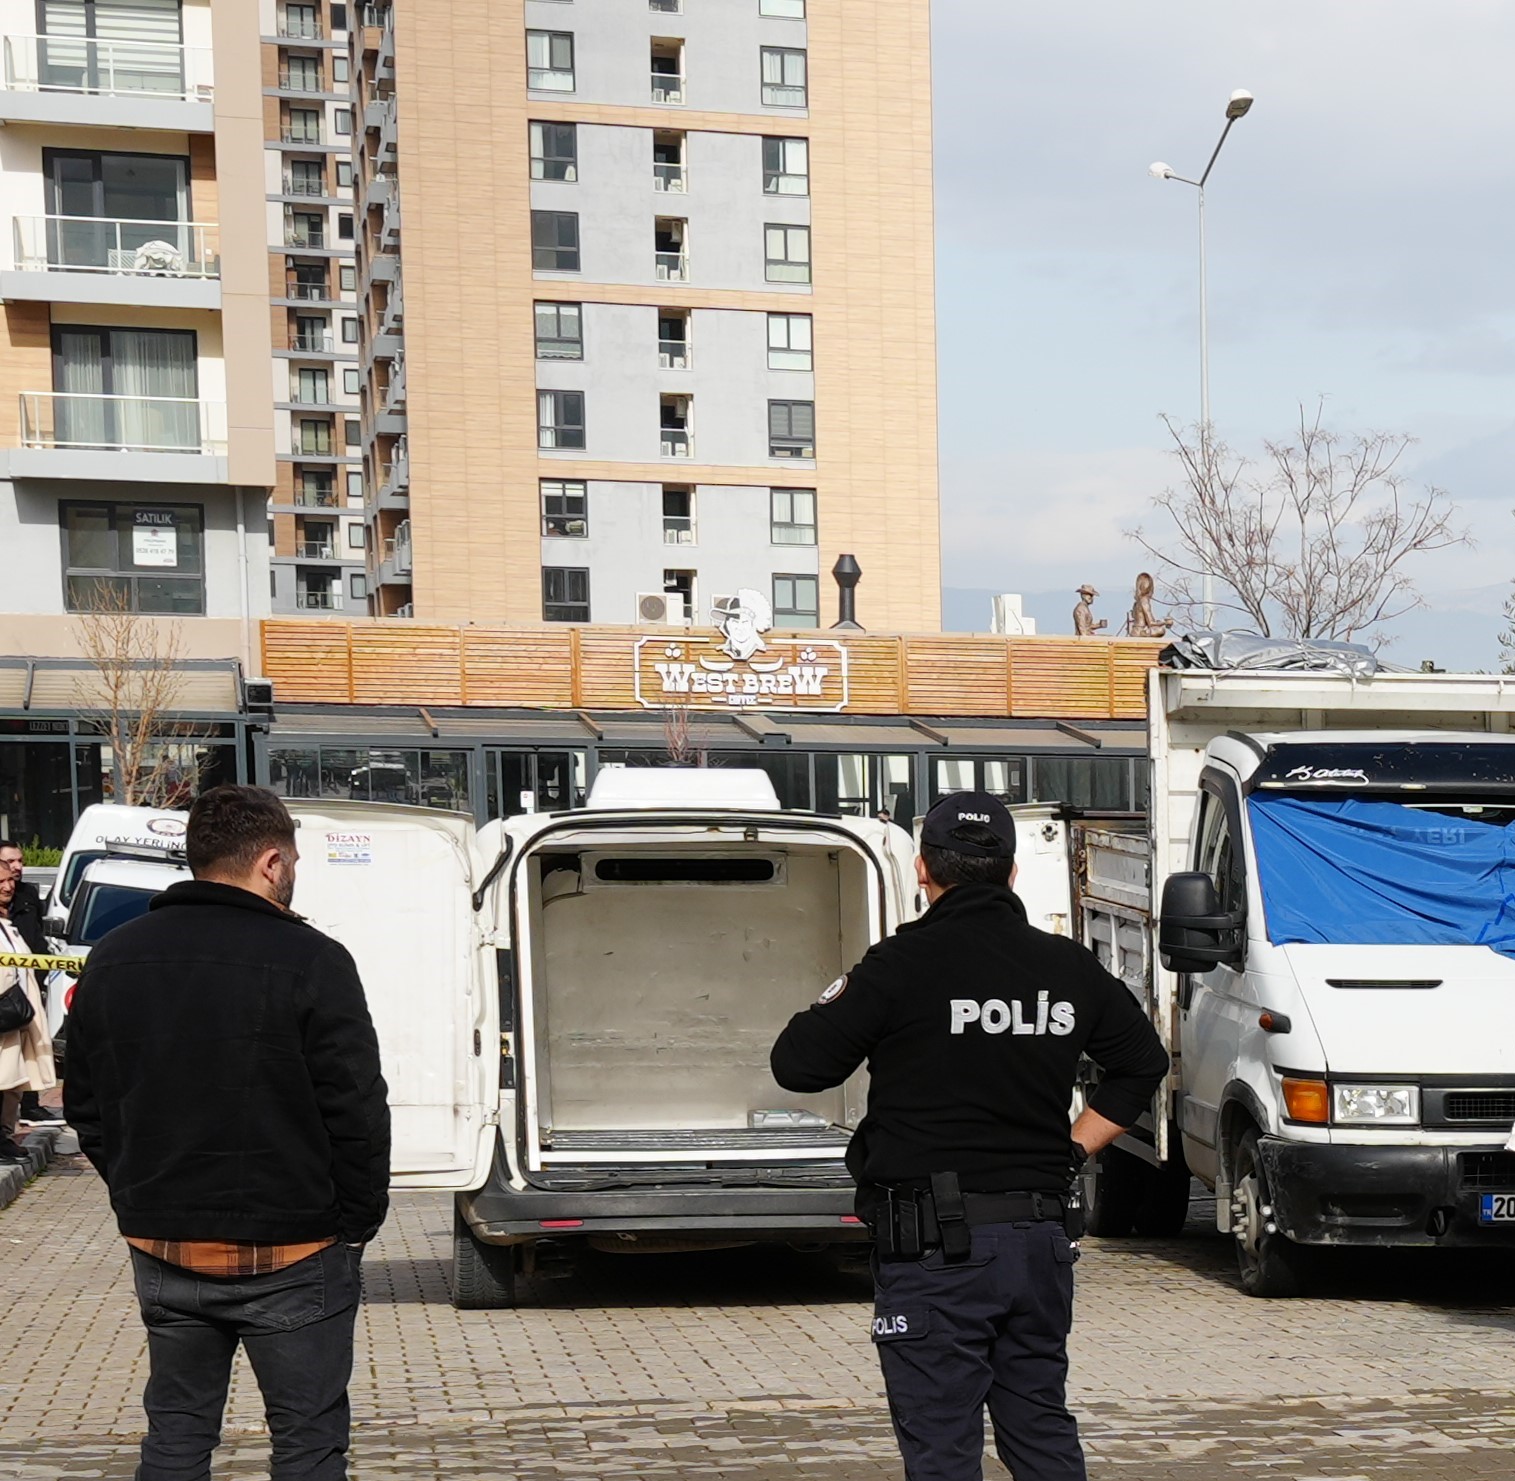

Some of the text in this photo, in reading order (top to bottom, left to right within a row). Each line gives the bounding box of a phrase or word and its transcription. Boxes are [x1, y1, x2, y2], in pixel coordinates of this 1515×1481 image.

[135, 512, 172, 524] SATILIK
[654, 662, 829, 695] WEST BREW
